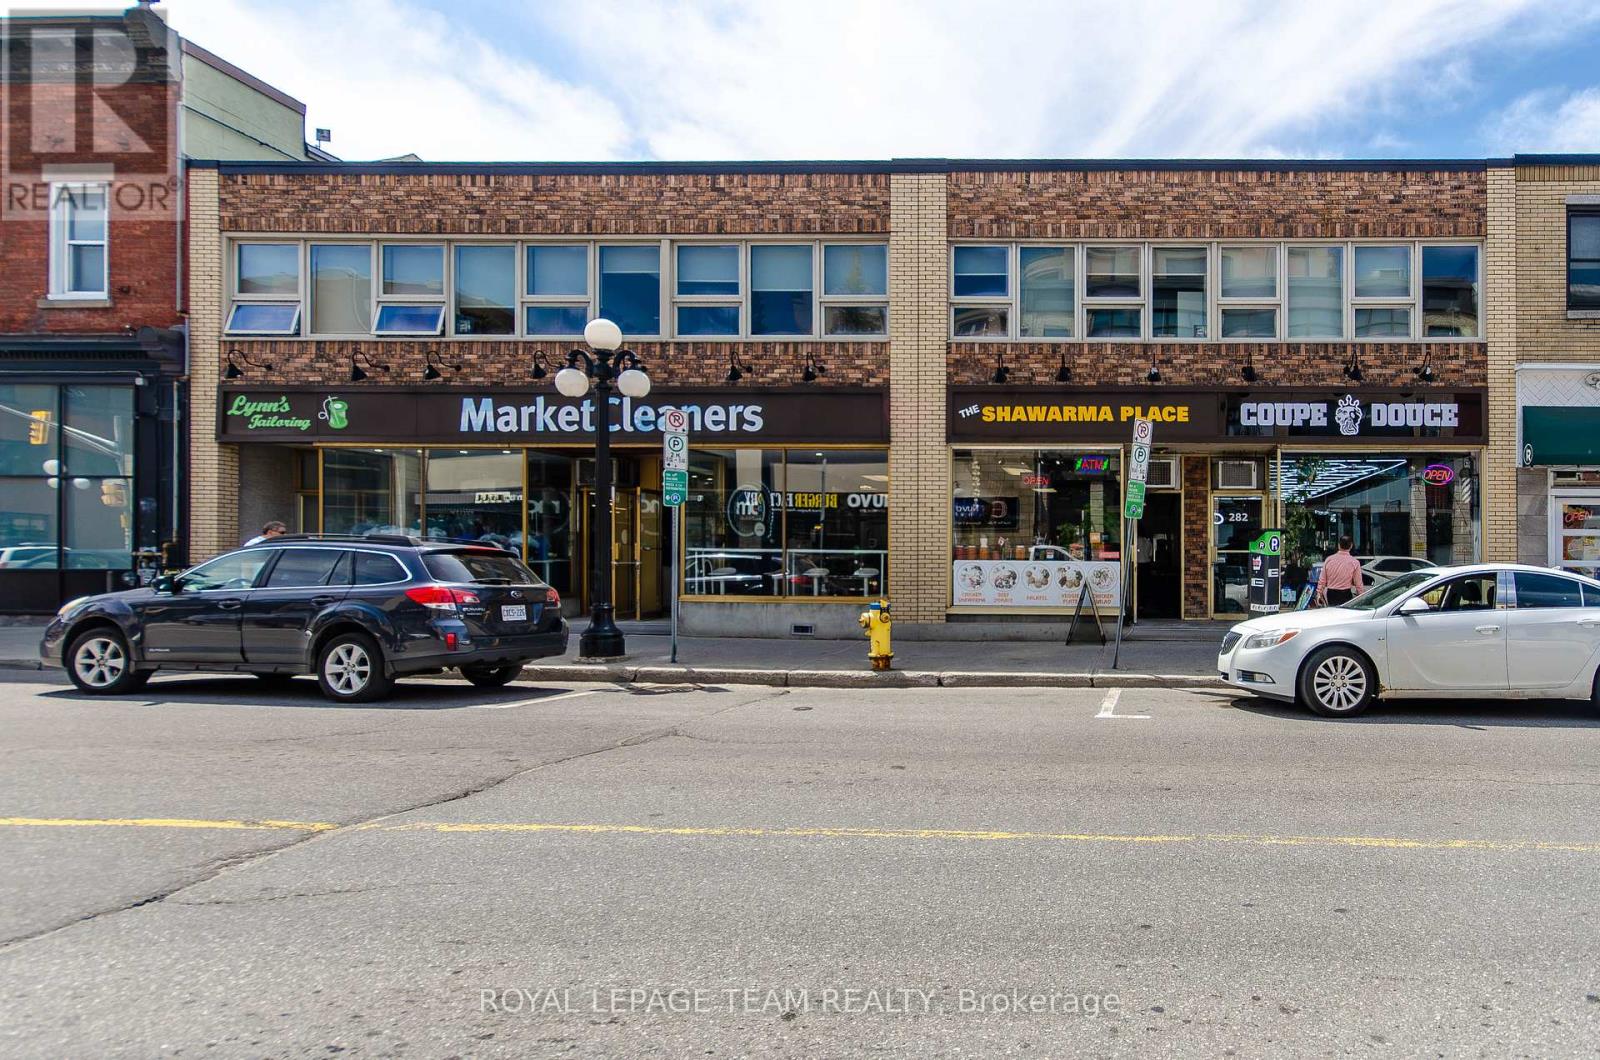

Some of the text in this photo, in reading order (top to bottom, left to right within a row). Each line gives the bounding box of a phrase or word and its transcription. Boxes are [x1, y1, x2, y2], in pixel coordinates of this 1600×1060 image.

[227, 394, 291, 416] Lynn's
[460, 395, 596, 432] Market
[958, 404, 1189, 422] THE SHAWARMA PLACE
[1240, 402, 1459, 427] COUPE DOUCE
[248, 414, 311, 431] Tailoring
[1081, 459, 1104, 470] ATM
[1023, 475, 1049, 485] OPEN
[1424, 469, 1451, 481] OPEN
[1228, 513, 1249, 522] 282
[1564, 509, 1594, 523] OPEN
